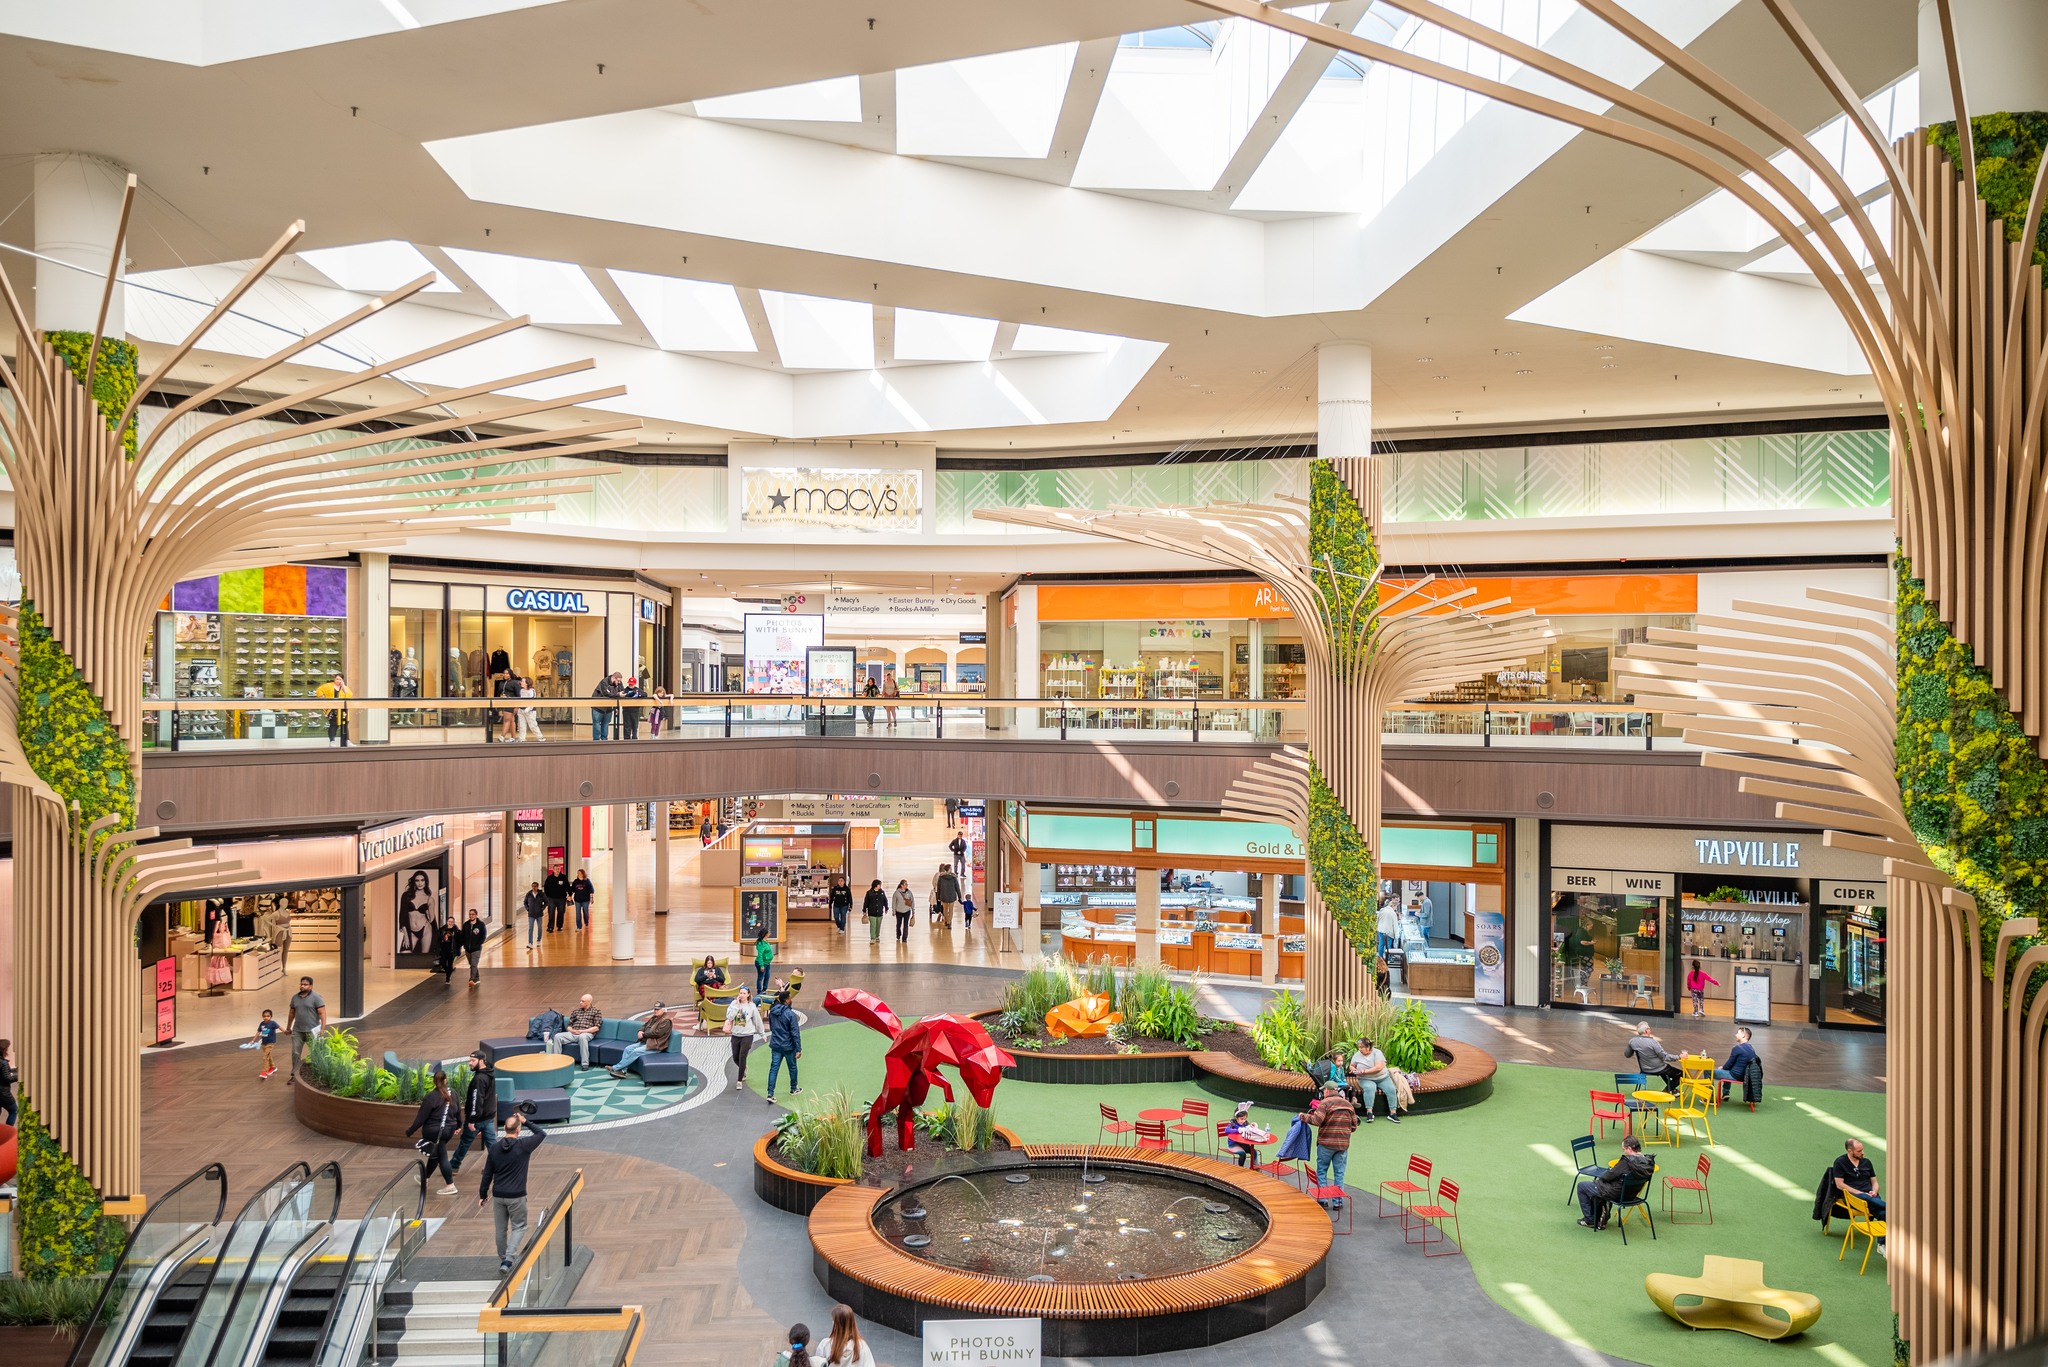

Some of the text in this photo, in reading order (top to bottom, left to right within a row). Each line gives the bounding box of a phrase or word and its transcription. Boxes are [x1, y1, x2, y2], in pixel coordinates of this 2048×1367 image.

[794, 484, 898, 519] macy's
[508, 590, 588, 612] CASUAL
[915, 597, 936, 605] Bunny
[945, 597, 957, 605] Dry
[862, 605, 880, 613] Eagle
[782, 626, 813, 634] BUNNY
[1149, 628, 1212, 638] STATION
[1496, 671, 1546, 684] ARTS ON FIRE
[796, 802, 815, 810] Macy's
[361, 830, 414, 862] VICTORIA'S
[1246, 842, 1280, 855] Gold
[1283, 844, 1295, 855] &
[1695, 839, 1799, 868] TAPVILLE
[741, 877, 778, 885] DIRECTORY
[1566, 875, 1597, 887] BEER
[1625, 878, 1662, 890] WINE
[1742, 889, 1800, 906] TAPVILLE
[1833, 888, 1875, 900] CIDER
[1708, 910, 1737, 923] While
[1740, 912, 1762, 926] You
[1763, 912, 1791, 927] Shop
[158, 980, 173, 993] $25
[158, 1021, 172, 1034] $35
[950, 1336, 1015, 1348] PHOTOS
[930, 1348, 1035, 1362] WITH BUNNY
